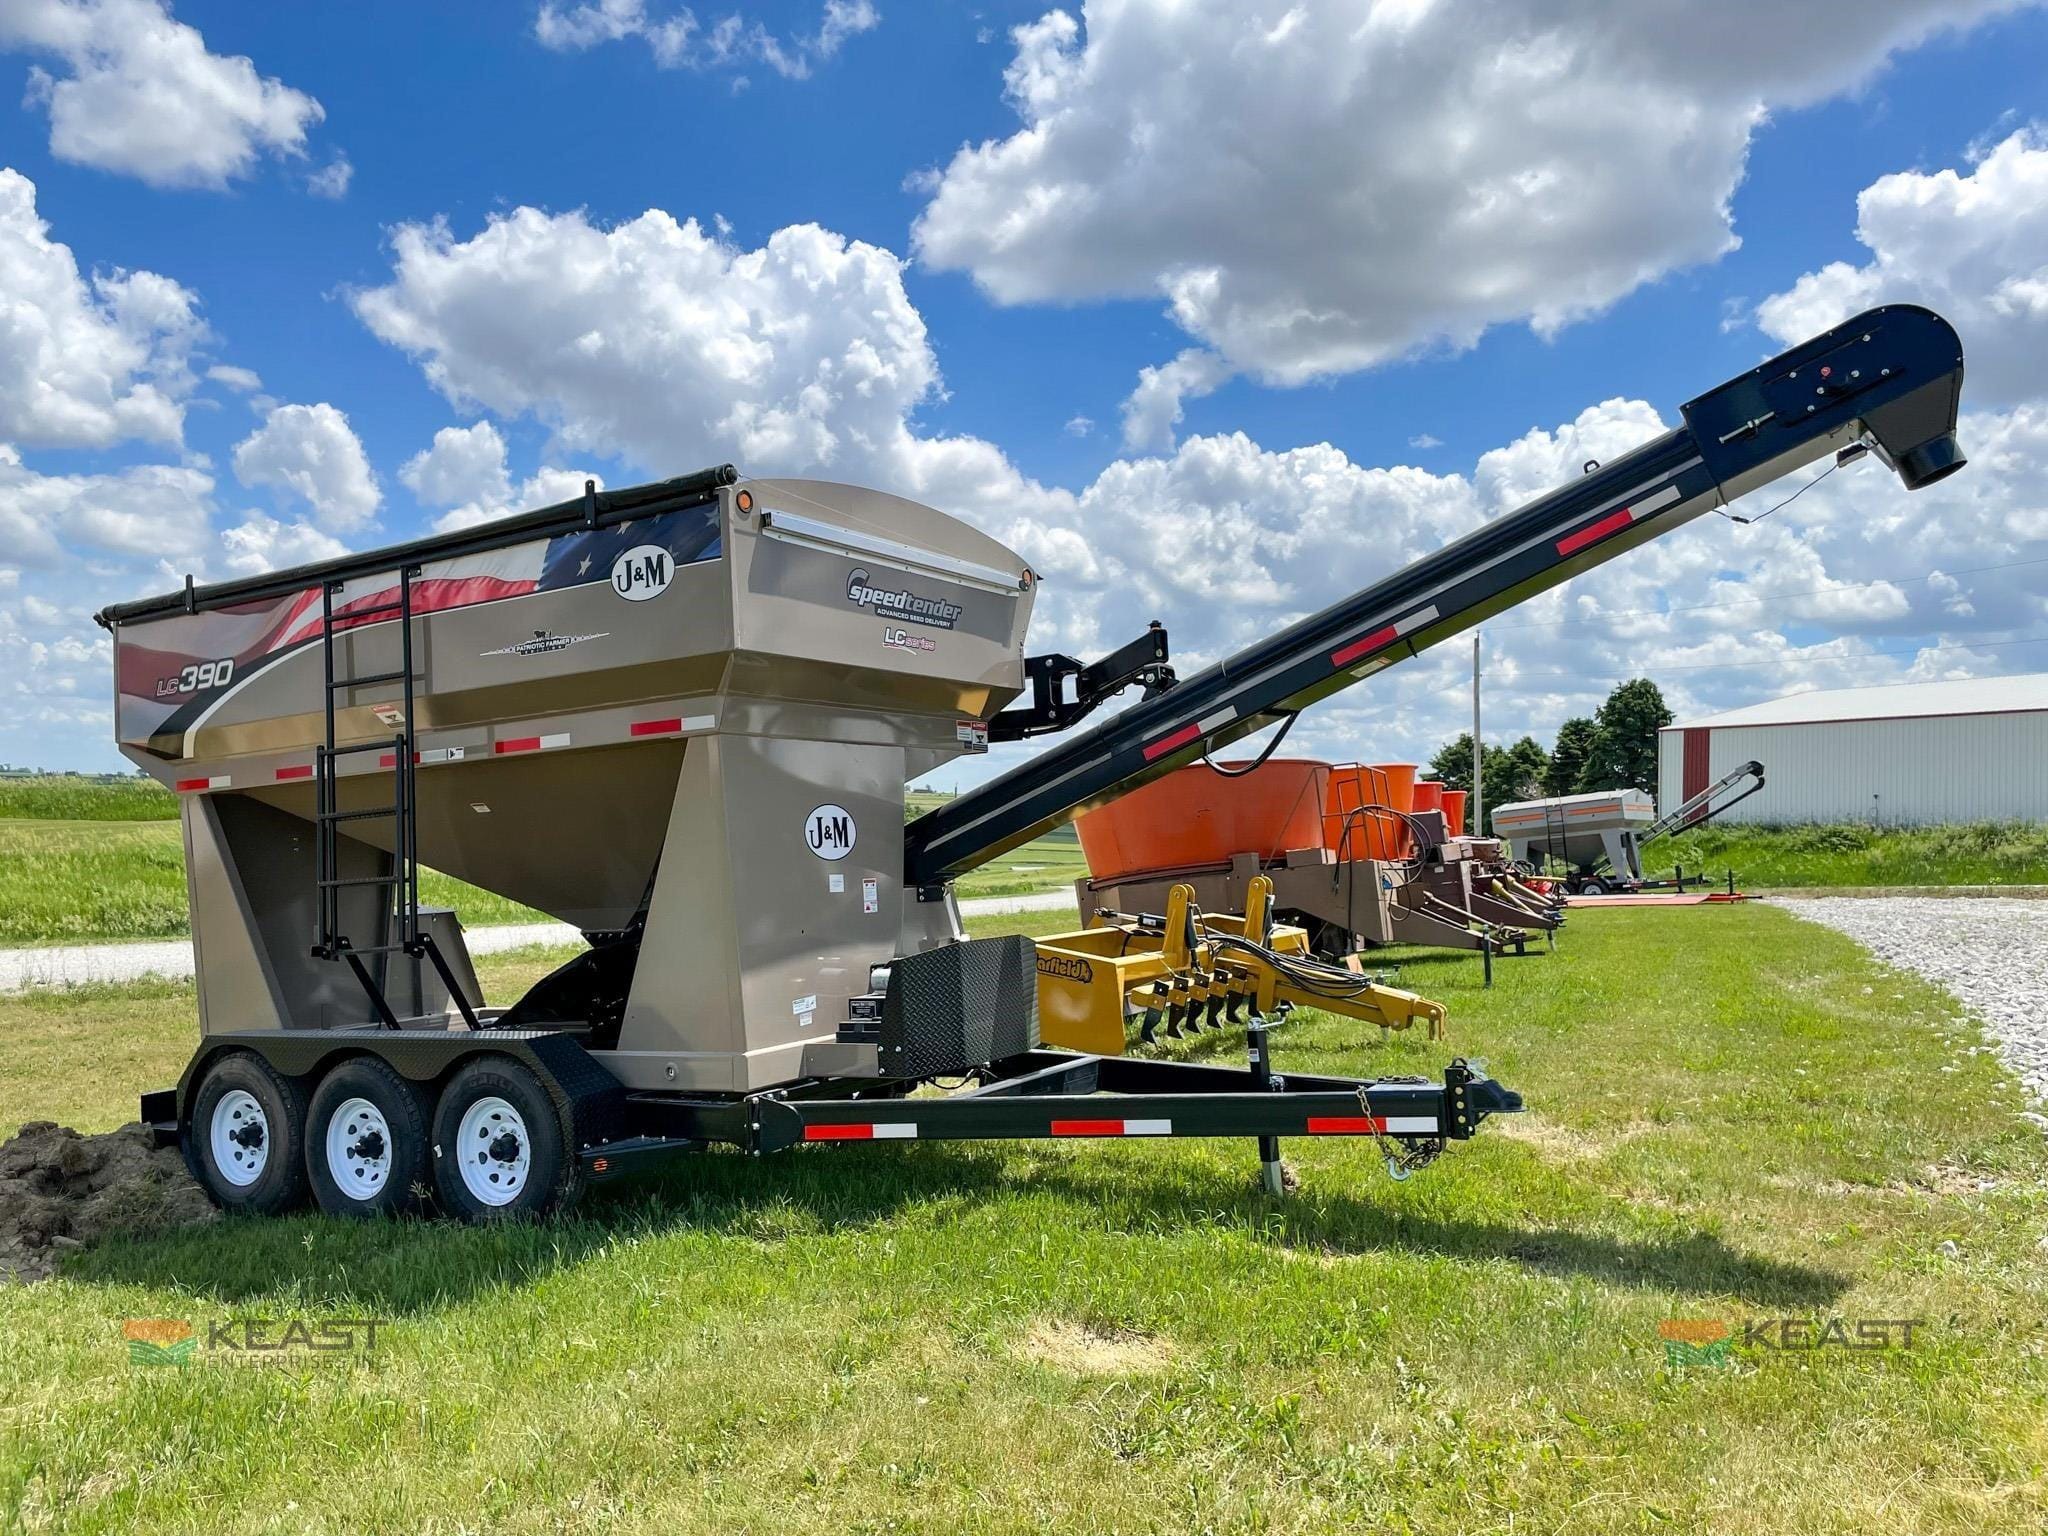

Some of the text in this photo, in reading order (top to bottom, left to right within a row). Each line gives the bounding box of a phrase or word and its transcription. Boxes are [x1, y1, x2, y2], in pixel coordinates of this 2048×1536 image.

[616, 553, 666, 593] J&M
[877, 608, 951, 627] ADVANCED SEED DELIVERY
[516, 641, 545, 652] PATRIOTIC
[546, 638, 570, 648] FARMER
[809, 816, 850, 849] J&M
[1037, 955, 1081, 979] arfield
